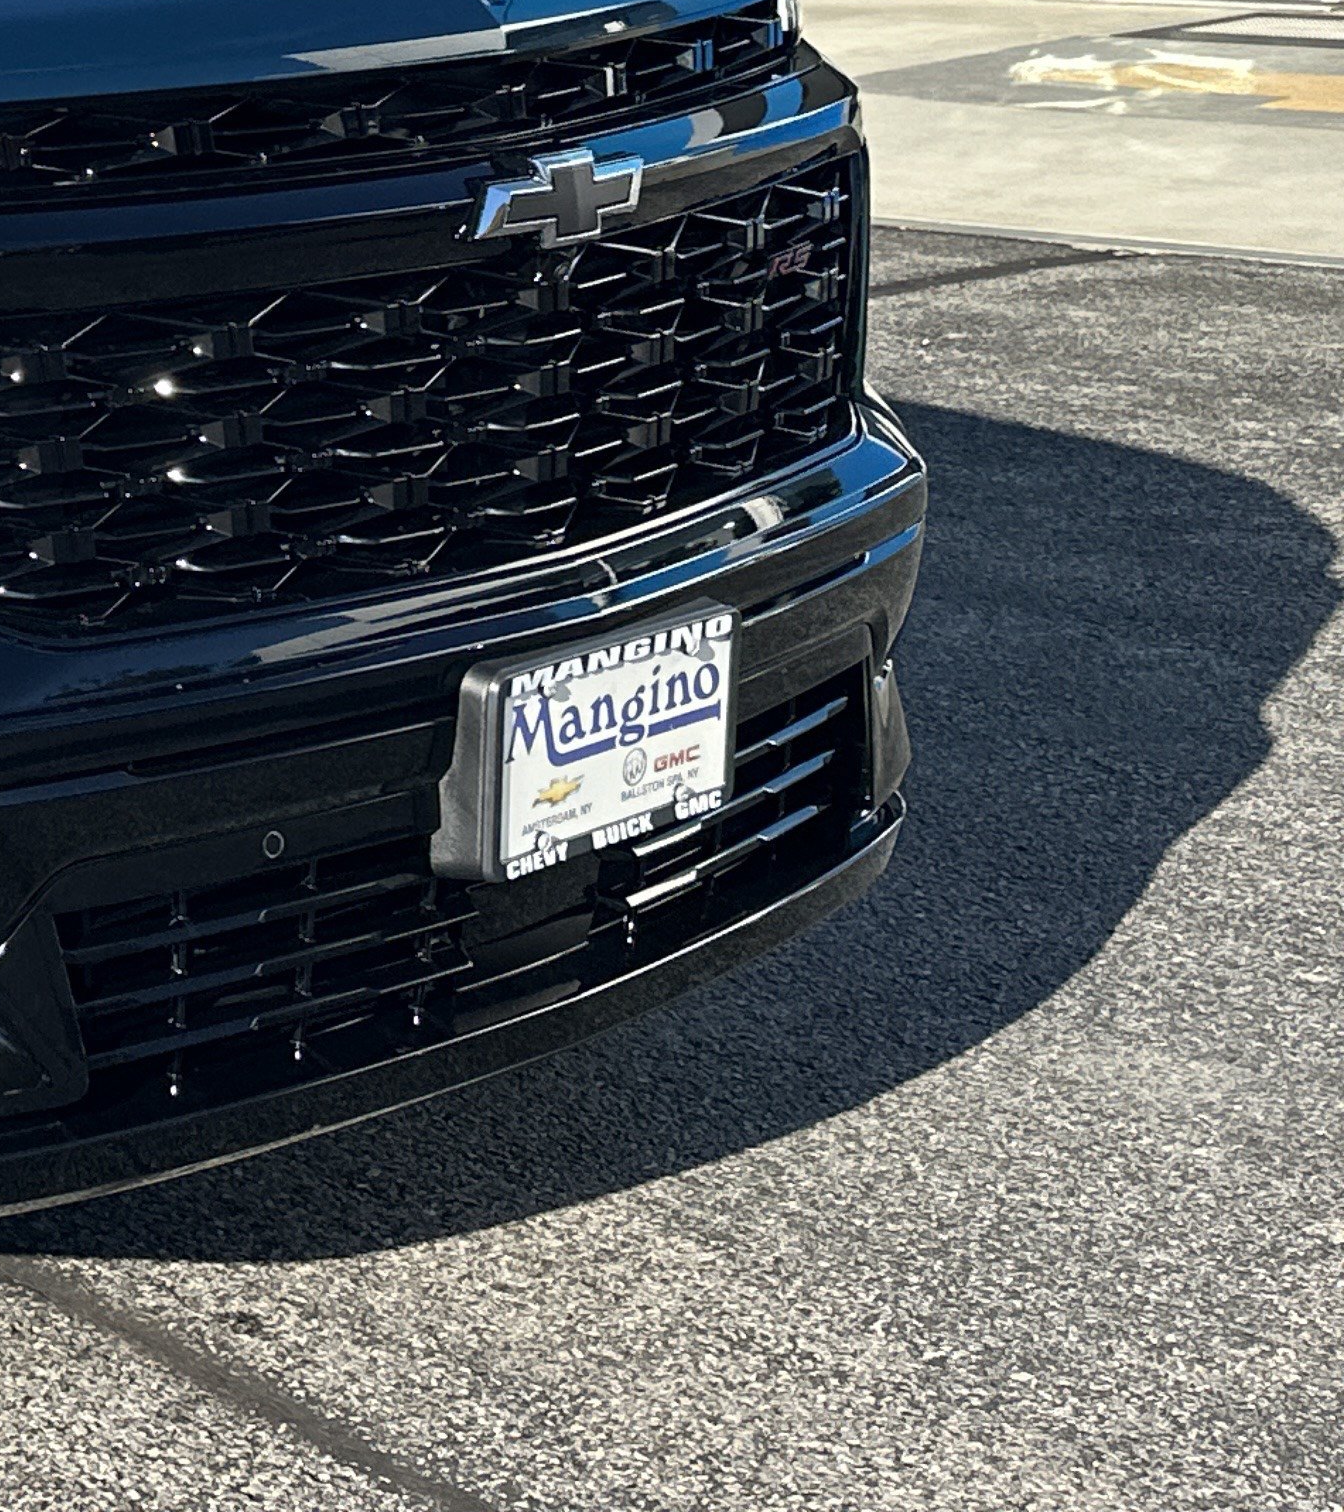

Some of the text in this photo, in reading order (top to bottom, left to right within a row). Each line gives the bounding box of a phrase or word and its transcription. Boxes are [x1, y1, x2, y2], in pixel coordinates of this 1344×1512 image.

[768, 243, 814, 279] RS
[510, 614, 733, 698] MANGINO
[505, 663, 721, 765] Mangino
[653, 744, 701, 772] GMC
[620, 779, 665, 802] BALLSTON
[687, 766, 700, 779] NY
[580, 803, 593, 816] NY
[506, 789, 722, 880] CHEVY BUICK GMC
